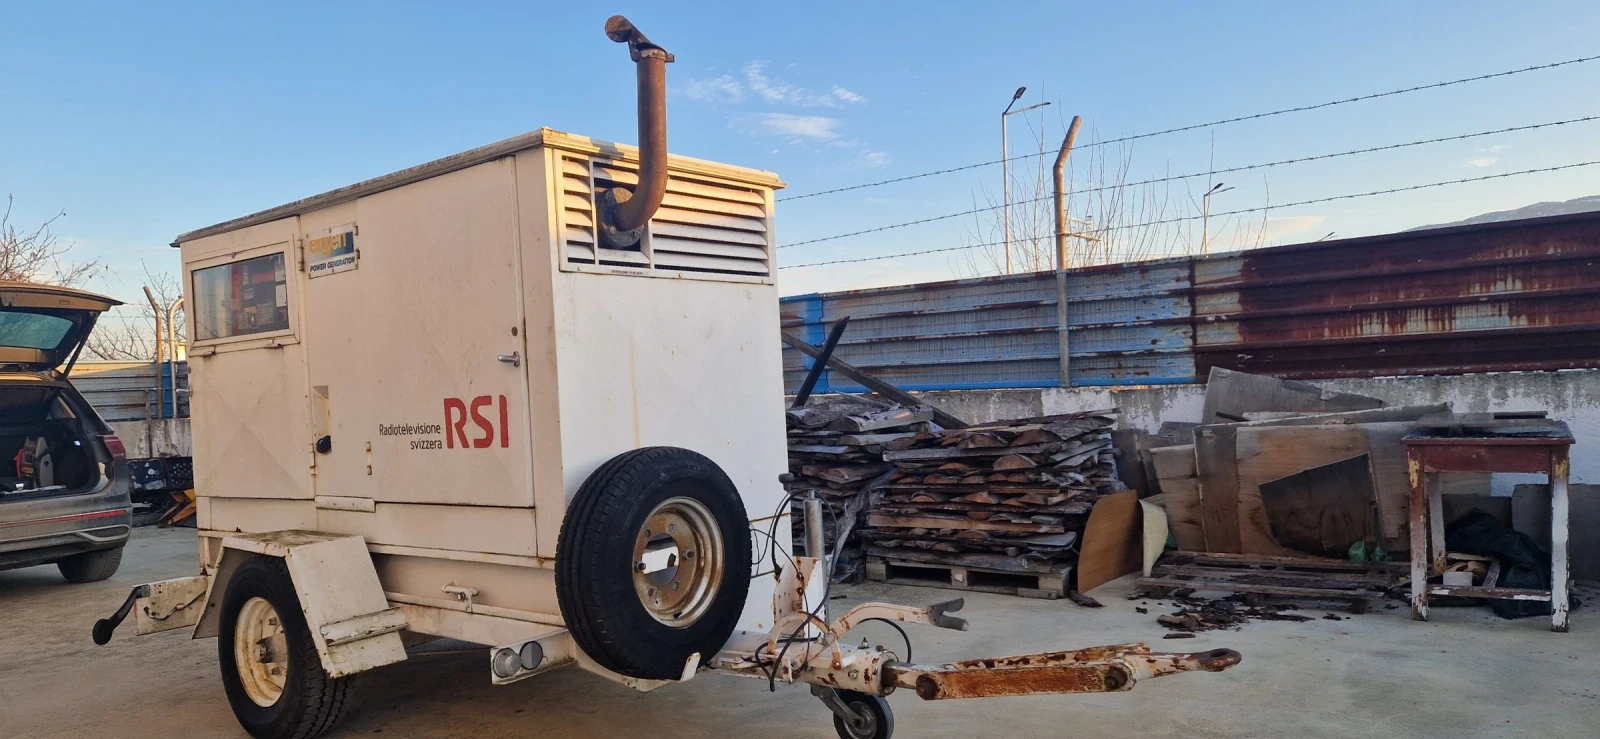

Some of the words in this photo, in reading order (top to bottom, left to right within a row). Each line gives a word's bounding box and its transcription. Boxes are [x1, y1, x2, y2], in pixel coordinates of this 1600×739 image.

[310, 263, 326, 272] POWER
[327, 257, 355, 269] GENERATION
[443, 394, 509, 449] RSI
[379, 422, 441, 436] Radiotelevisione
[410, 438, 442, 450] svizzera
